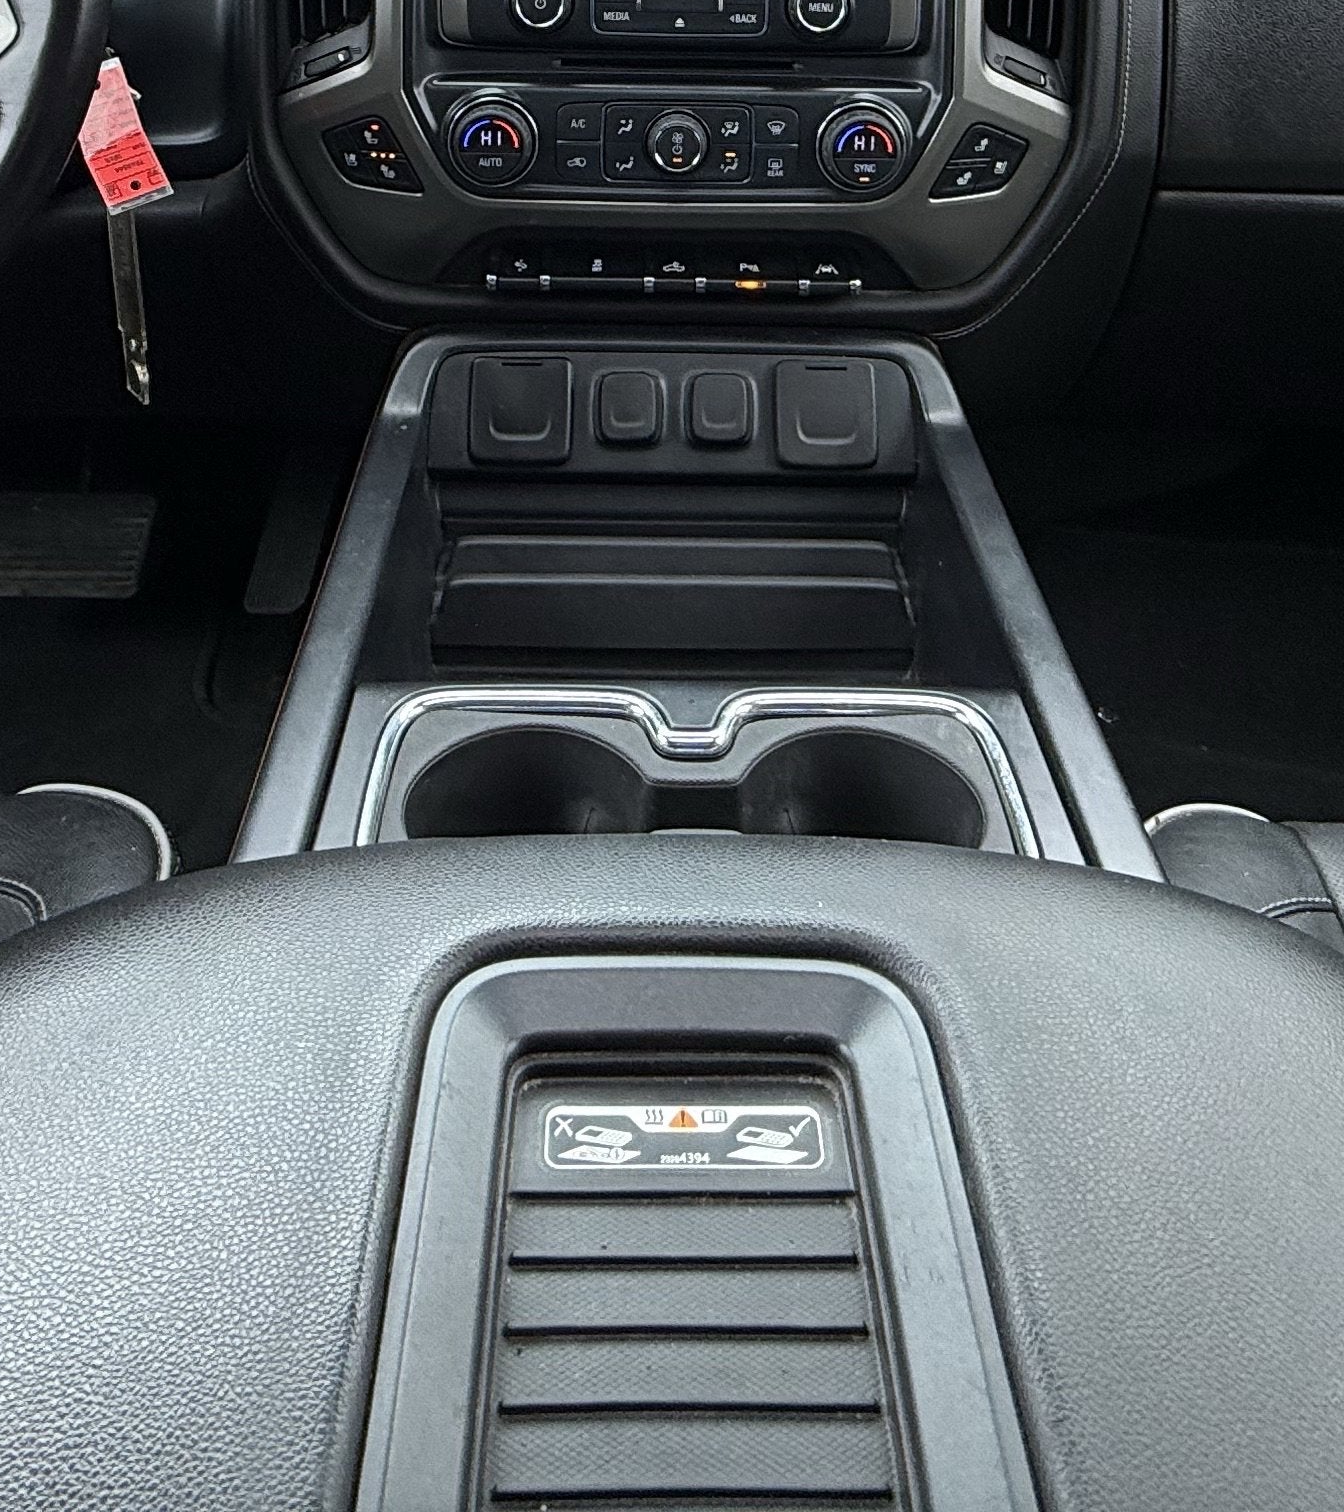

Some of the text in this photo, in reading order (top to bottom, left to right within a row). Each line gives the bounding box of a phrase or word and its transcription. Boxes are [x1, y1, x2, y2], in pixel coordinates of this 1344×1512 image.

[808, 2, 834, 13] MENU
[603, 11, 630, 22] MEDIA
[736, 14, 757, 24] BACK
[570, 119, 586, 128] A/C
[481, 130, 502, 146] HI
[854, 135, 876, 152] HI
[479, 157, 503, 167] AUTO
[854, 163, 877, 174] SYNC
